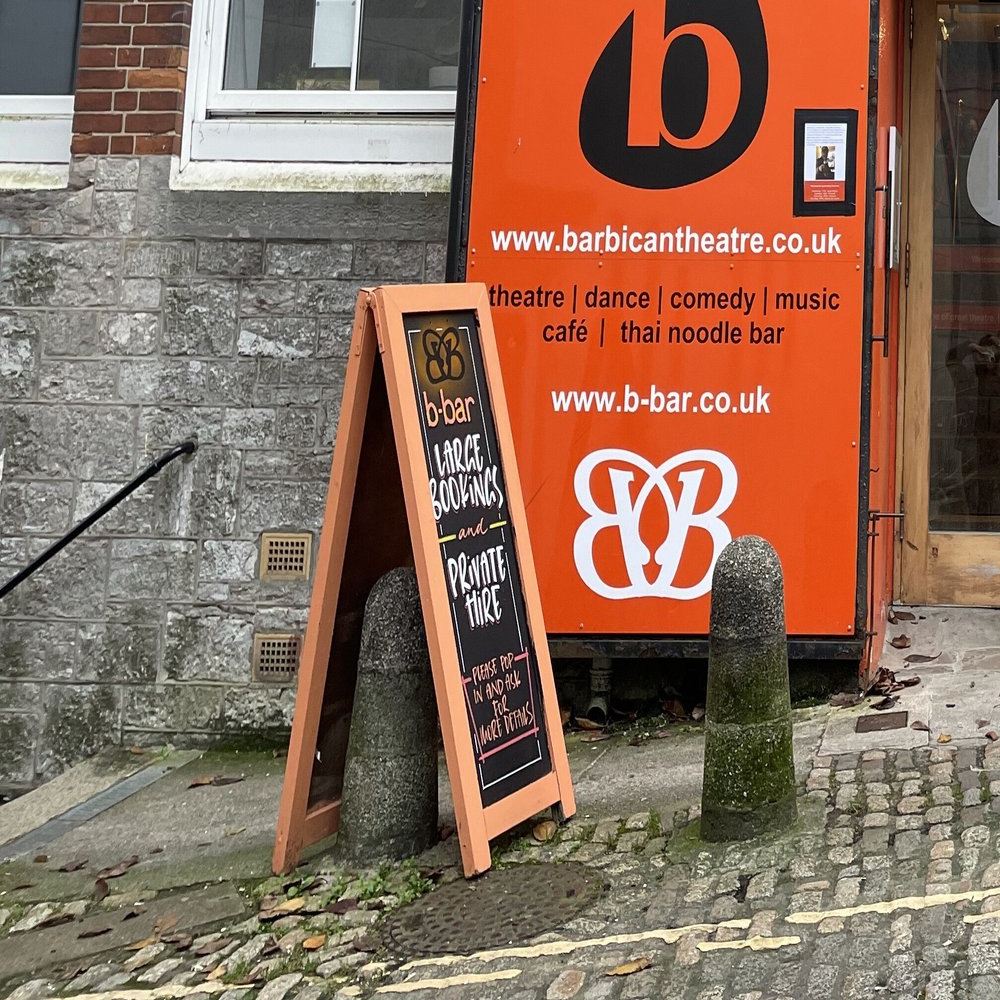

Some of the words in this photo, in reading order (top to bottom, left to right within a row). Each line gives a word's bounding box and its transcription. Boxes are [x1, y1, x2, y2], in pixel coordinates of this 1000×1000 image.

[491, 225, 842, 254] www.barbicantheatre.co.uk
[489, 284, 565, 308] theatre
[585, 285, 650, 309] dance
[670, 287, 756, 315] comedy
[775, 288, 840, 310] music
[542, 319, 588, 343] café
[621, 320, 661, 344] thai
[668, 321, 742, 345] noodle
[749, 322, 785, 345] bar
[423, 388, 475, 428] b-bar
[551, 384, 770, 414] www.b-bar.co.uk
[434, 433, 484, 478] LARGE
[458, 518, 489, 540] and
[472, 658, 498, 685] PLEASE
[500, 652, 514, 672] POP
[473, 685, 483, 704] IN
[486, 679, 504, 699] AND
[505, 670, 521, 691] ASK
[492, 694, 509, 719] FOR
[479, 719, 502, 746] MORE
[504, 701, 533, 734] DETAILS
